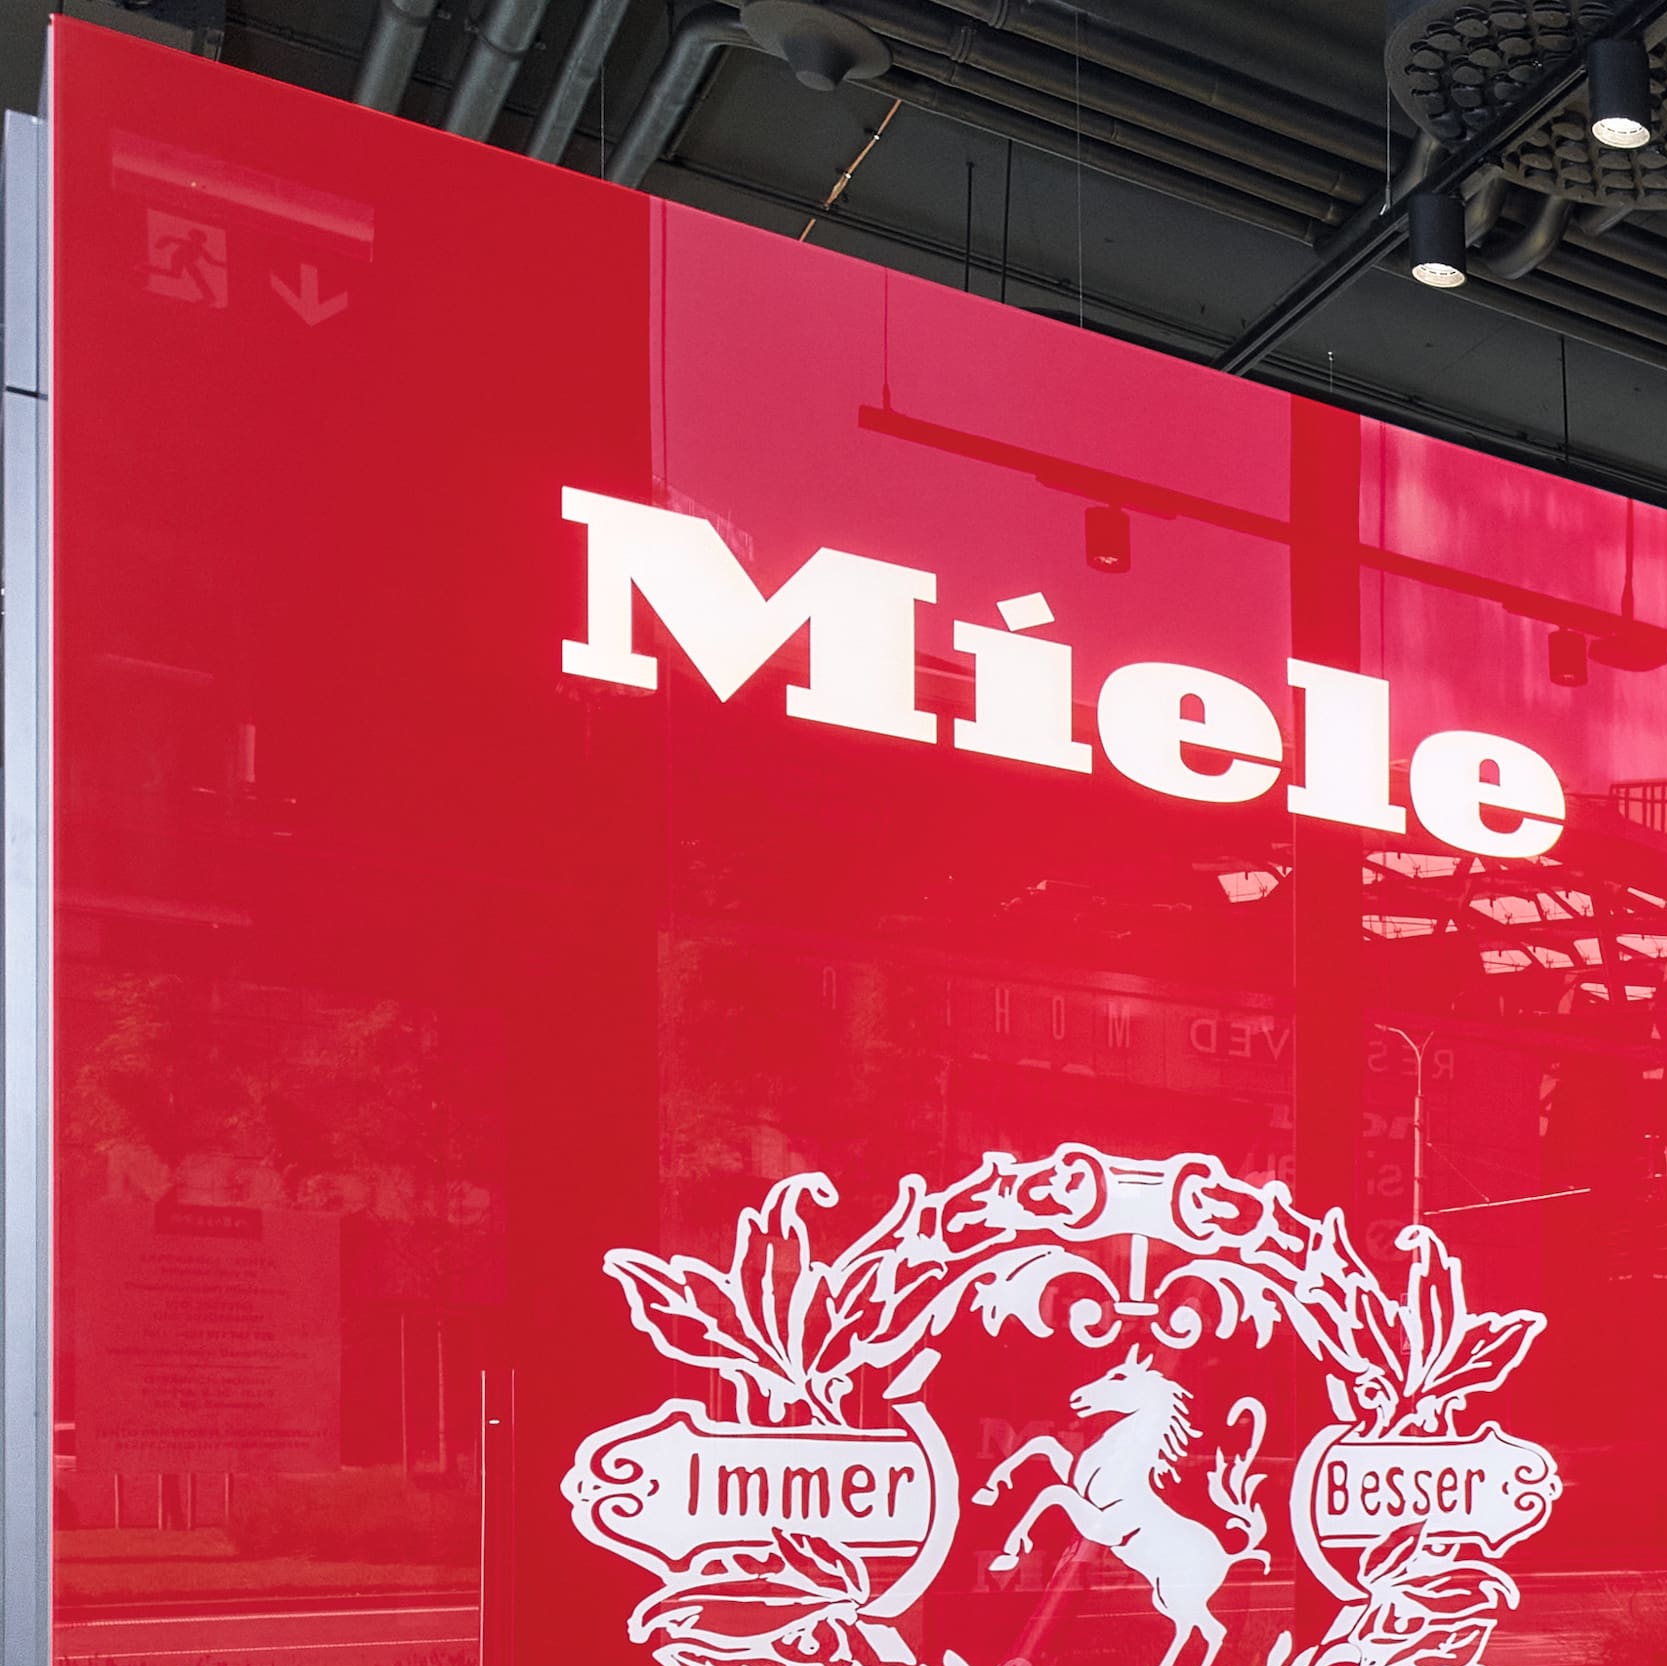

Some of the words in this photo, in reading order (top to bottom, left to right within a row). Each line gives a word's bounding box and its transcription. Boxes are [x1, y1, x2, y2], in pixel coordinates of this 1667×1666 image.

[562, 486, 1565, 858] Miele
[688, 1453, 915, 1520] Immer
[1327, 1460, 1486, 1517] Besser
